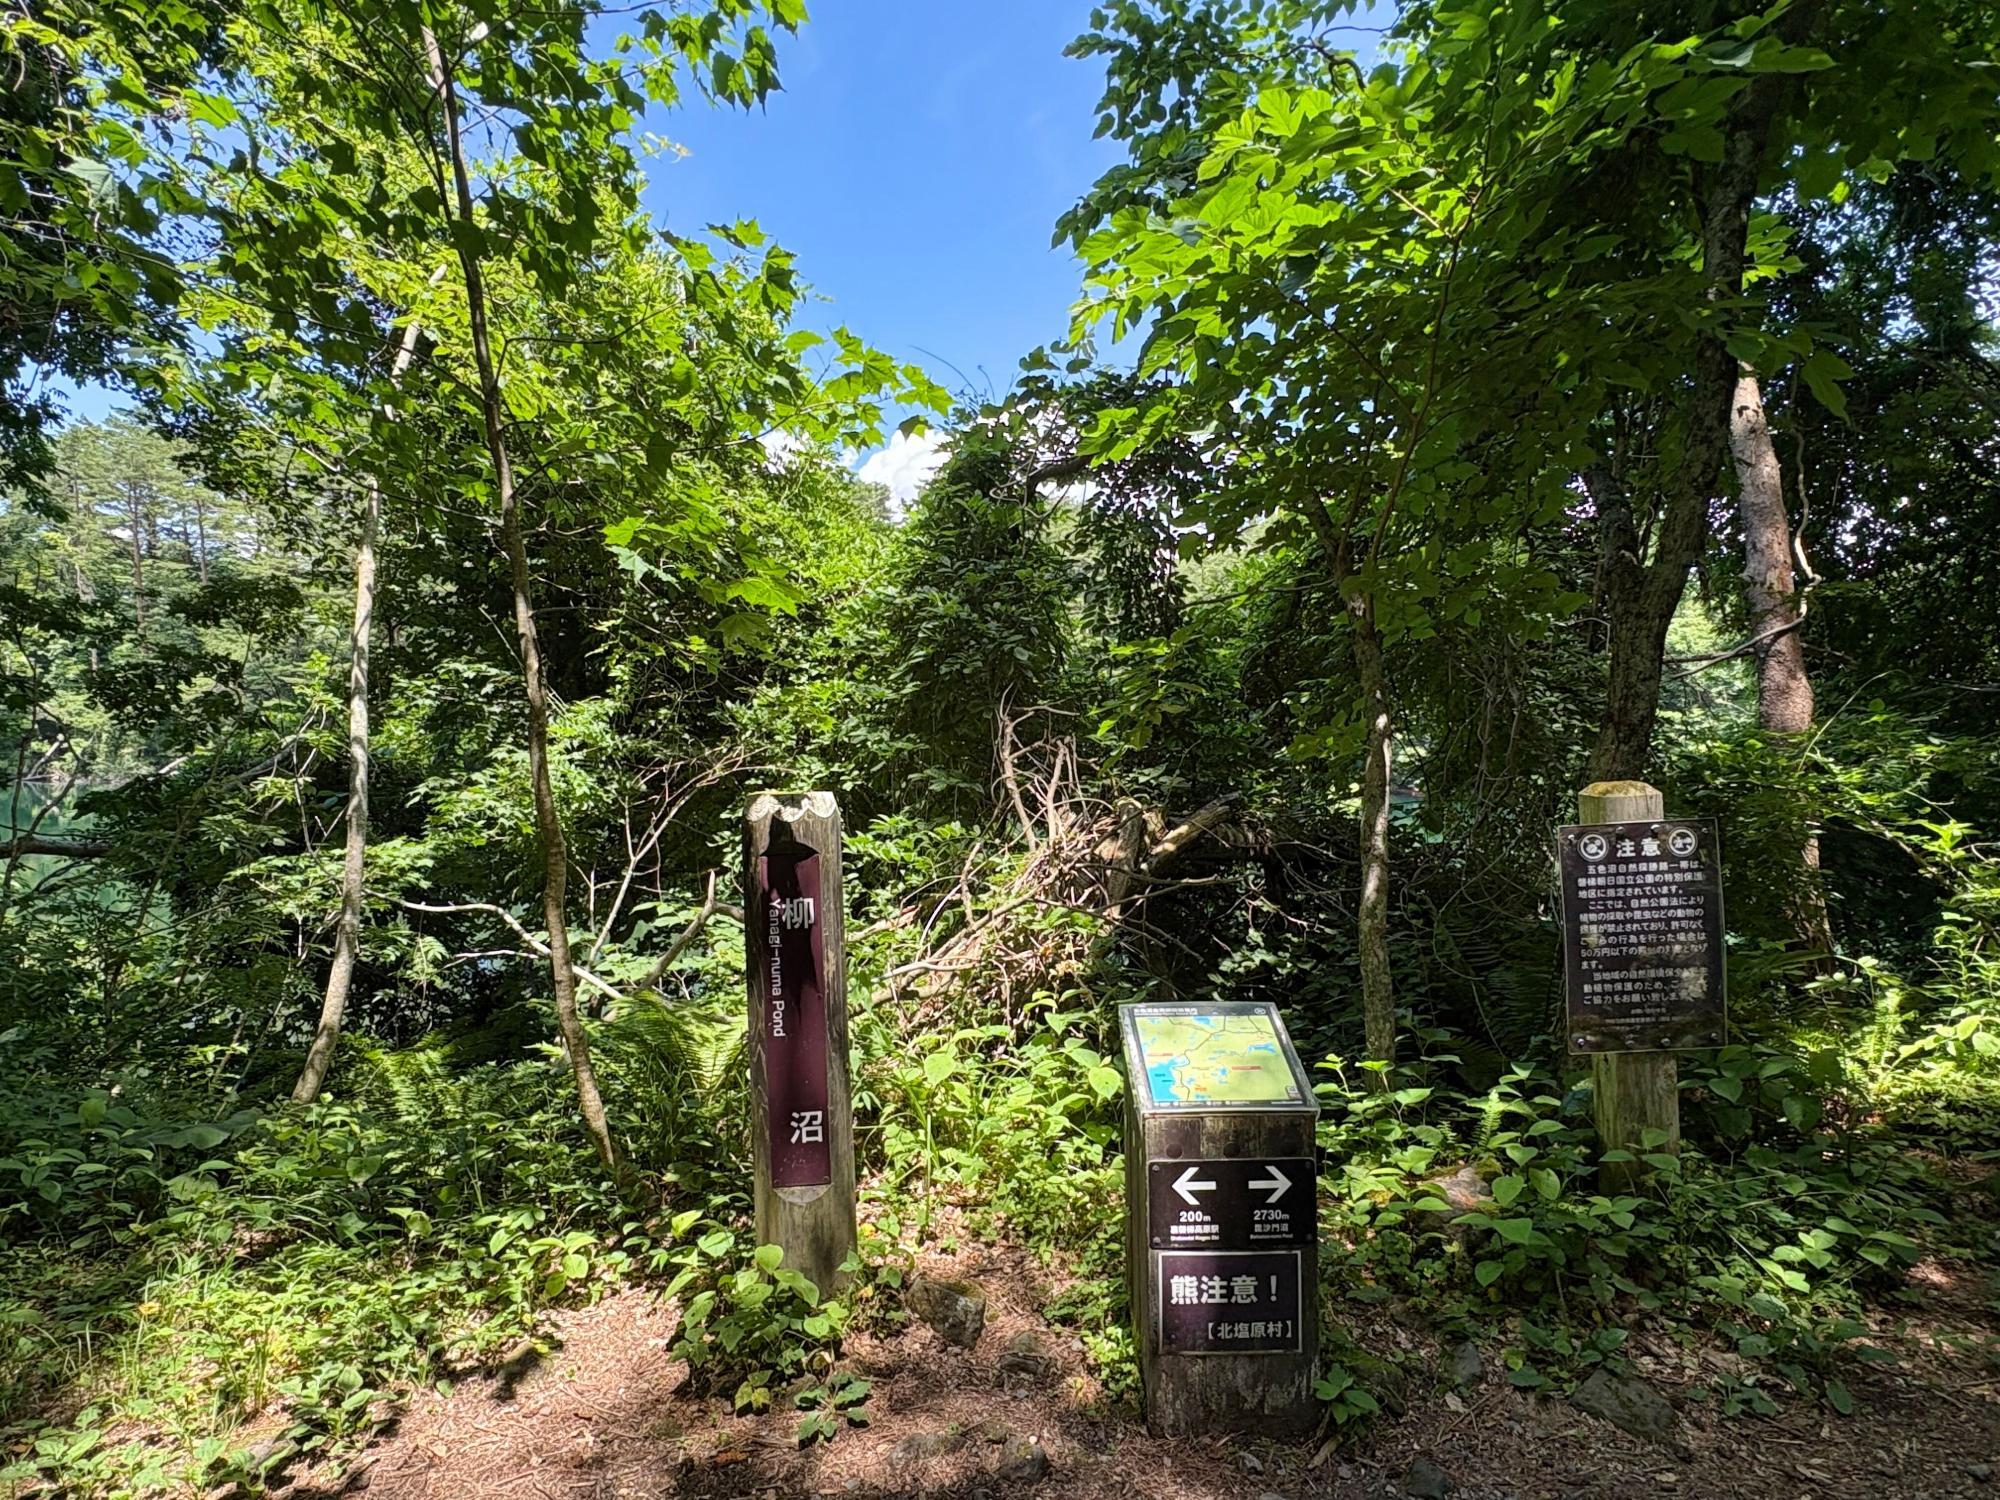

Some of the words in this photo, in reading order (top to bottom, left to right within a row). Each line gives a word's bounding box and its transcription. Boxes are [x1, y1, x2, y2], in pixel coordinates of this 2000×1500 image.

[1616, 837, 1661, 858] 注意
[781, 897, 815, 930] 柳
[768, 898, 783, 996] Yanagi-numa
[1580, 931, 1707, 947] こらの行為を行った場合は
[772, 1000, 786, 1037] Pond
[790, 1110, 823, 1144] 沼
[1179, 1210, 1211, 1223] 200m
[1253, 1209, 1290, 1221] 2730m
[1170, 1274, 1278, 1305] 熊注意！
[1207, 1320, 1293, 1340] 【北塩原村】
